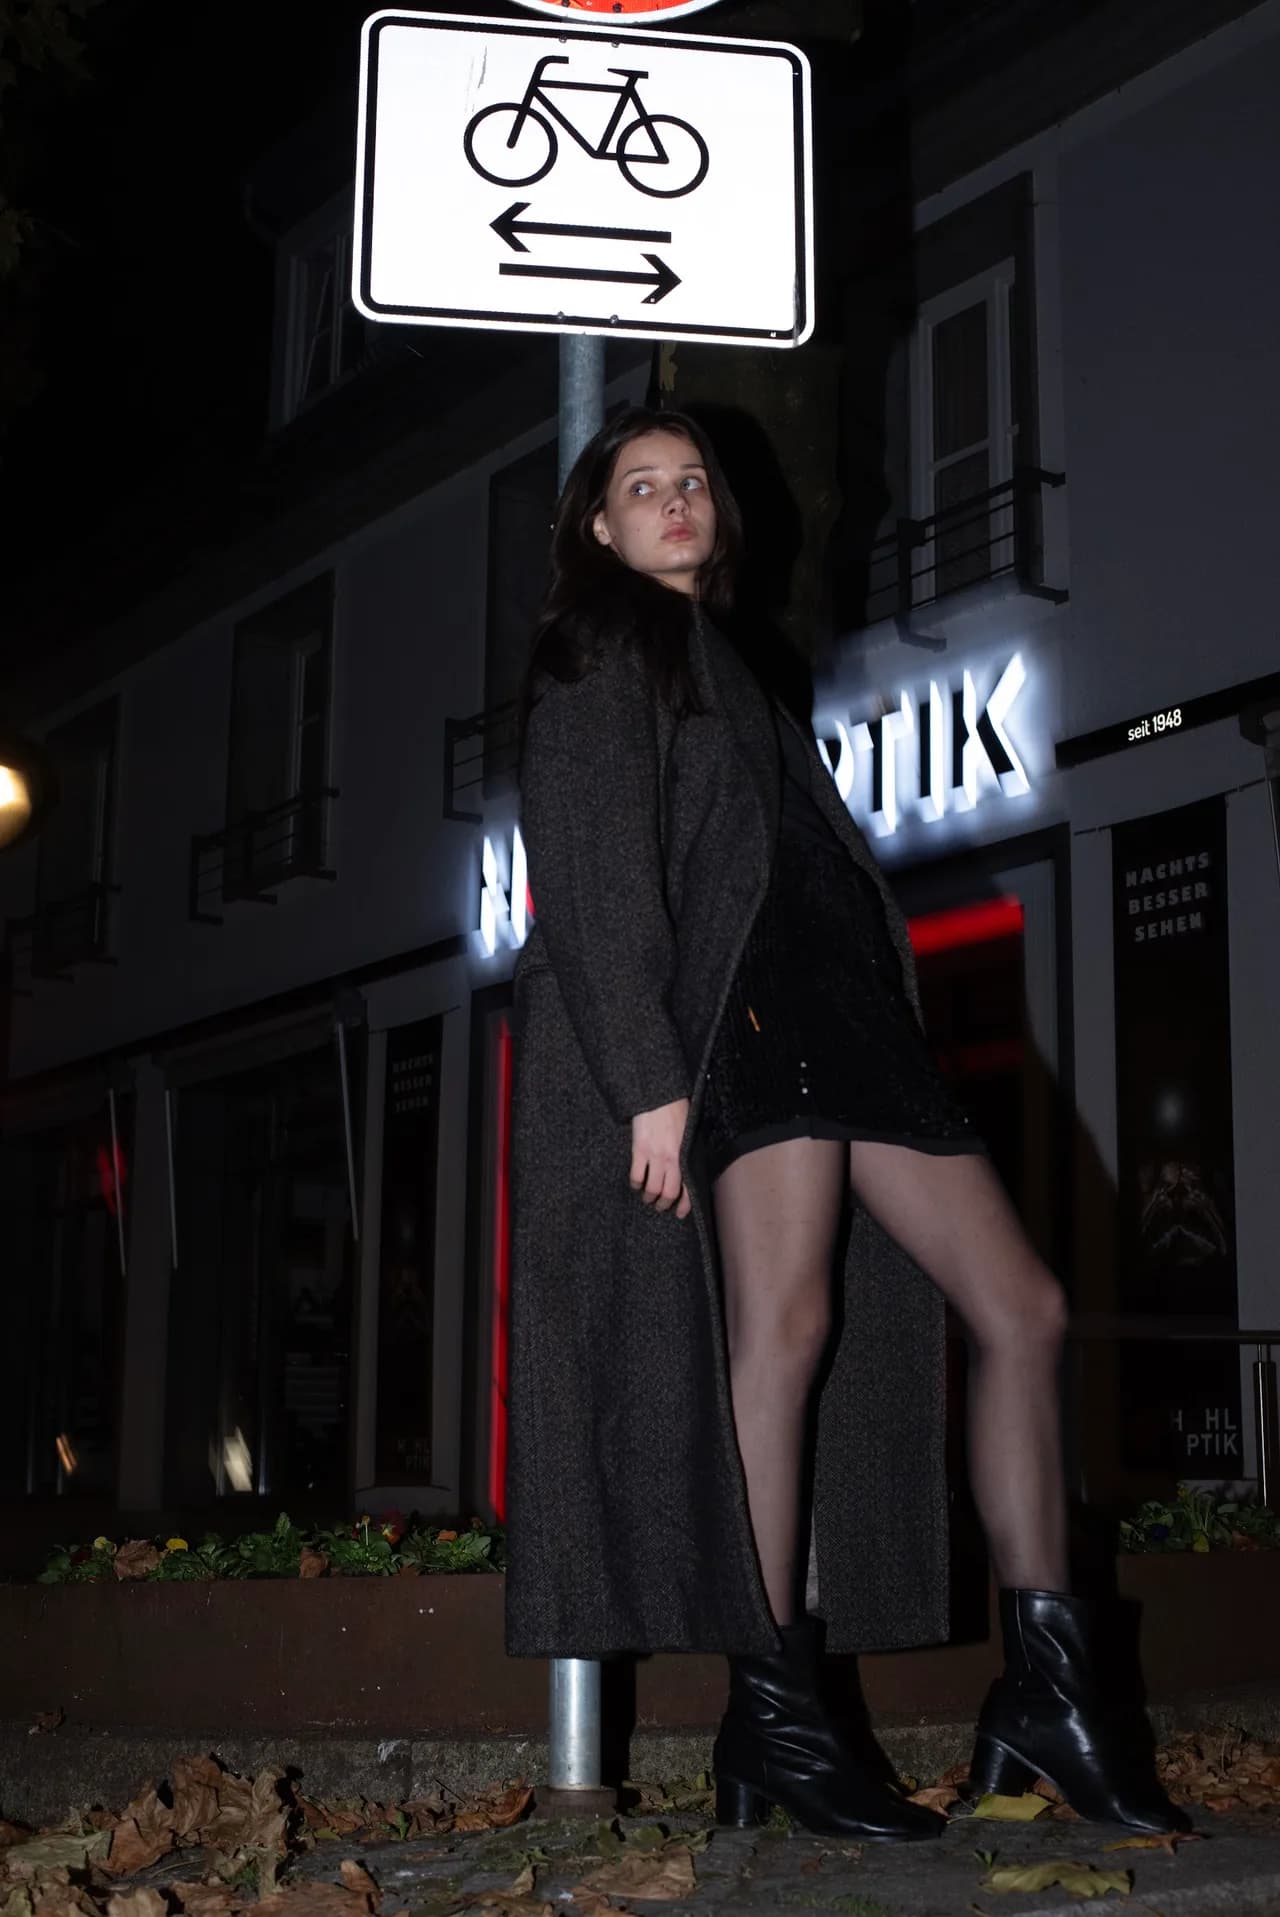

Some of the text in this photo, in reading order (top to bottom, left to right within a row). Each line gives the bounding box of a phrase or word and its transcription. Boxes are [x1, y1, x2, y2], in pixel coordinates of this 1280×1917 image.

[1127, 708, 1182, 741] seit 1948
[1125, 852, 1209, 889] NACHTS
[1128, 881, 1208, 915] BESSER
[1134, 911, 1202, 942] SEHEN
